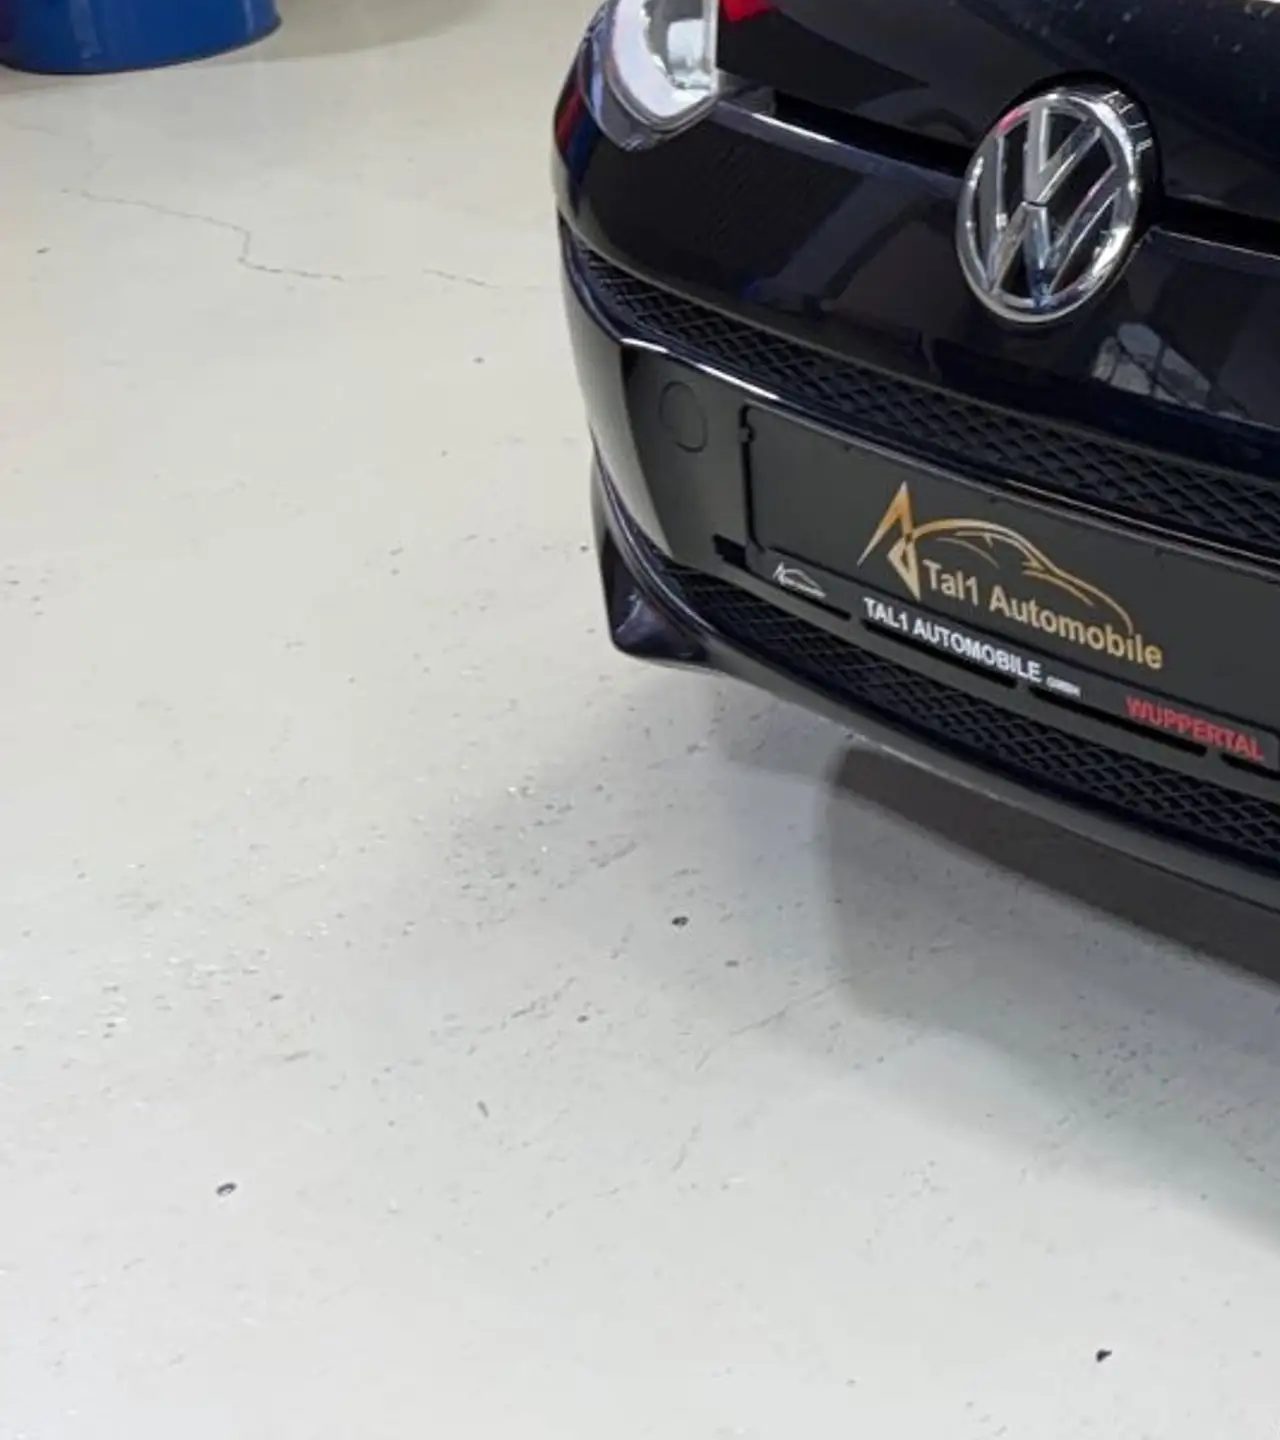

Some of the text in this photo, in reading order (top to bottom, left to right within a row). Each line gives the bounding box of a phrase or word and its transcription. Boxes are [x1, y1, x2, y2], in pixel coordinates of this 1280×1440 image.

[864, 596, 1042, 682] TAL1 AUTOMOBILE
[922, 559, 1164, 671] Tal1 Automobile
[1124, 694, 1265, 763] WUPPERTAL
